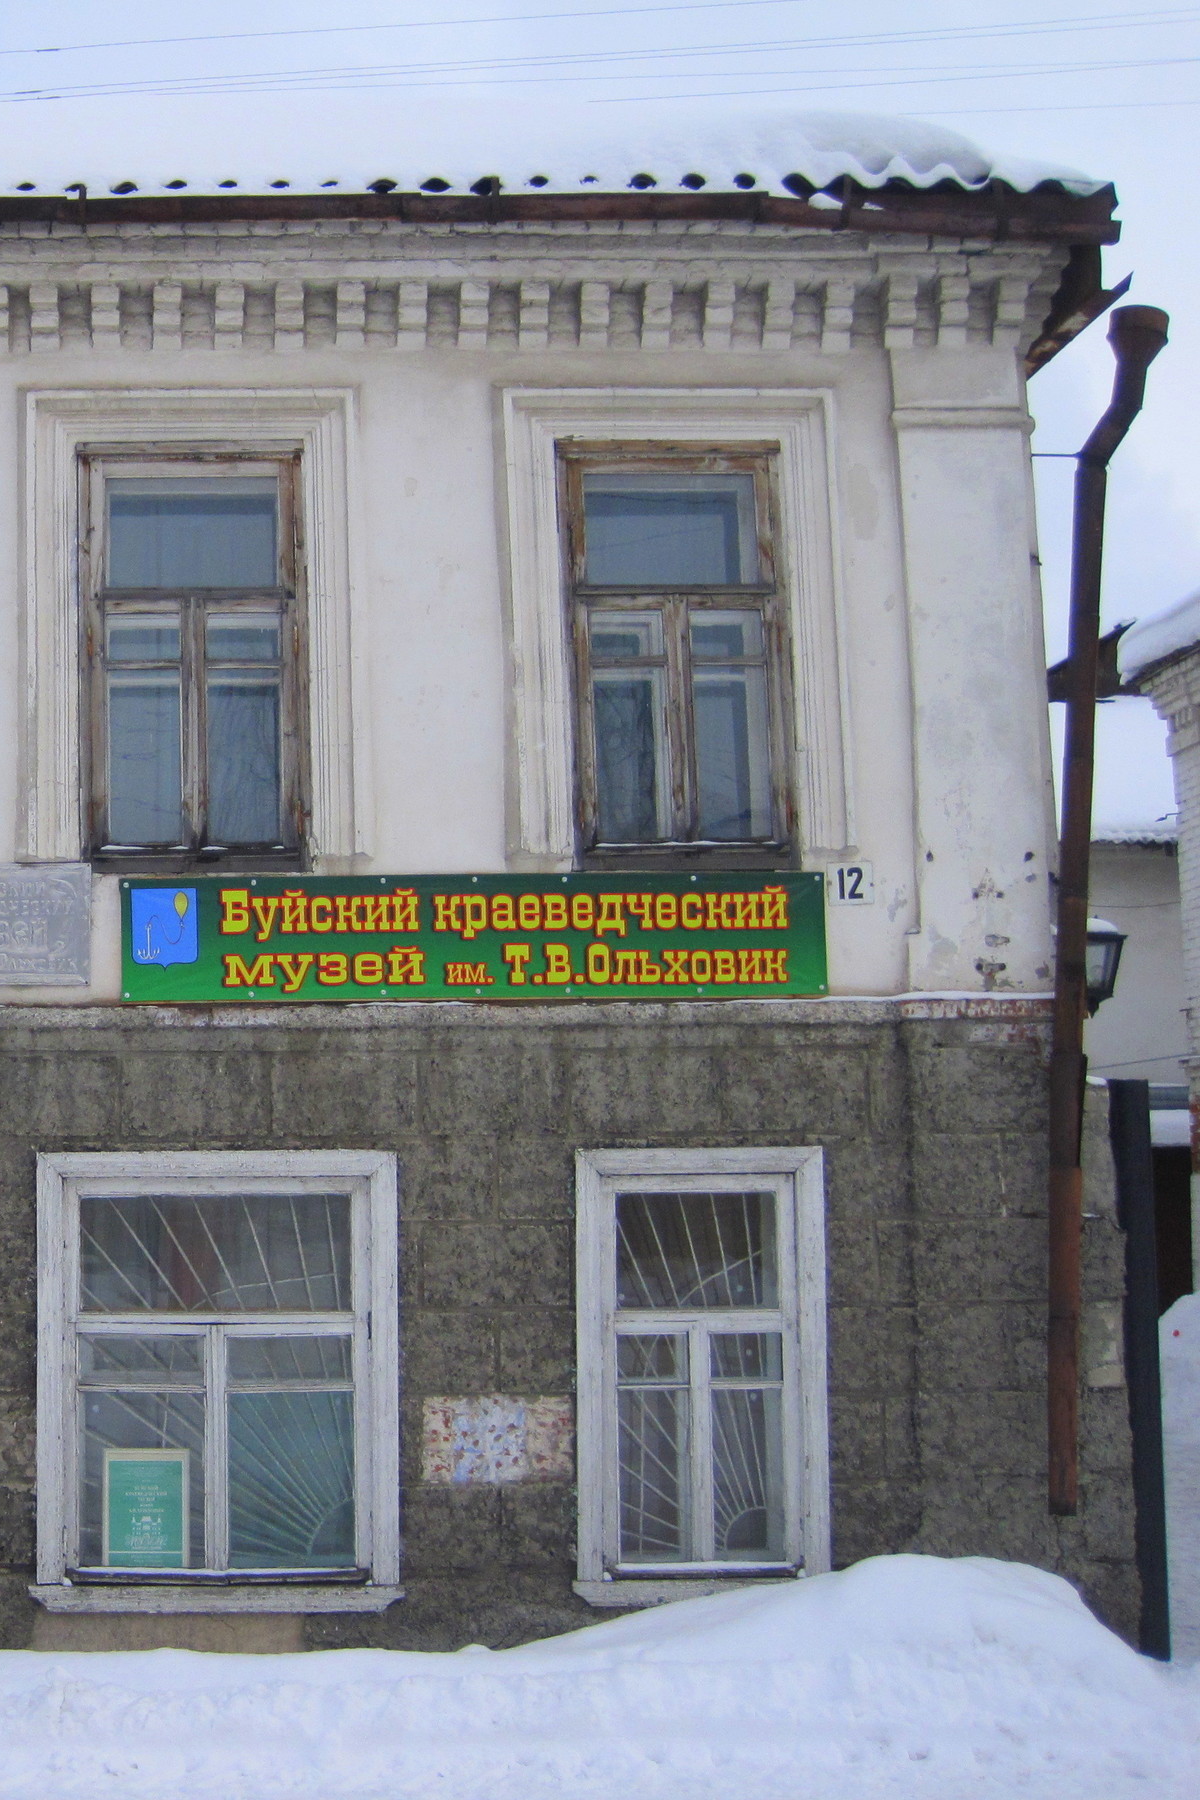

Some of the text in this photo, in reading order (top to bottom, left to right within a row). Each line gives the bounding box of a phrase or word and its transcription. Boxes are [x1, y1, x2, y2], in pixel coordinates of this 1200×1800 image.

[837, 867, 864, 900] 12
[220, 885, 789, 942] Буйский краеведческий
[223, 945, 426, 993] музей
[445, 961, 495, 986] им.
